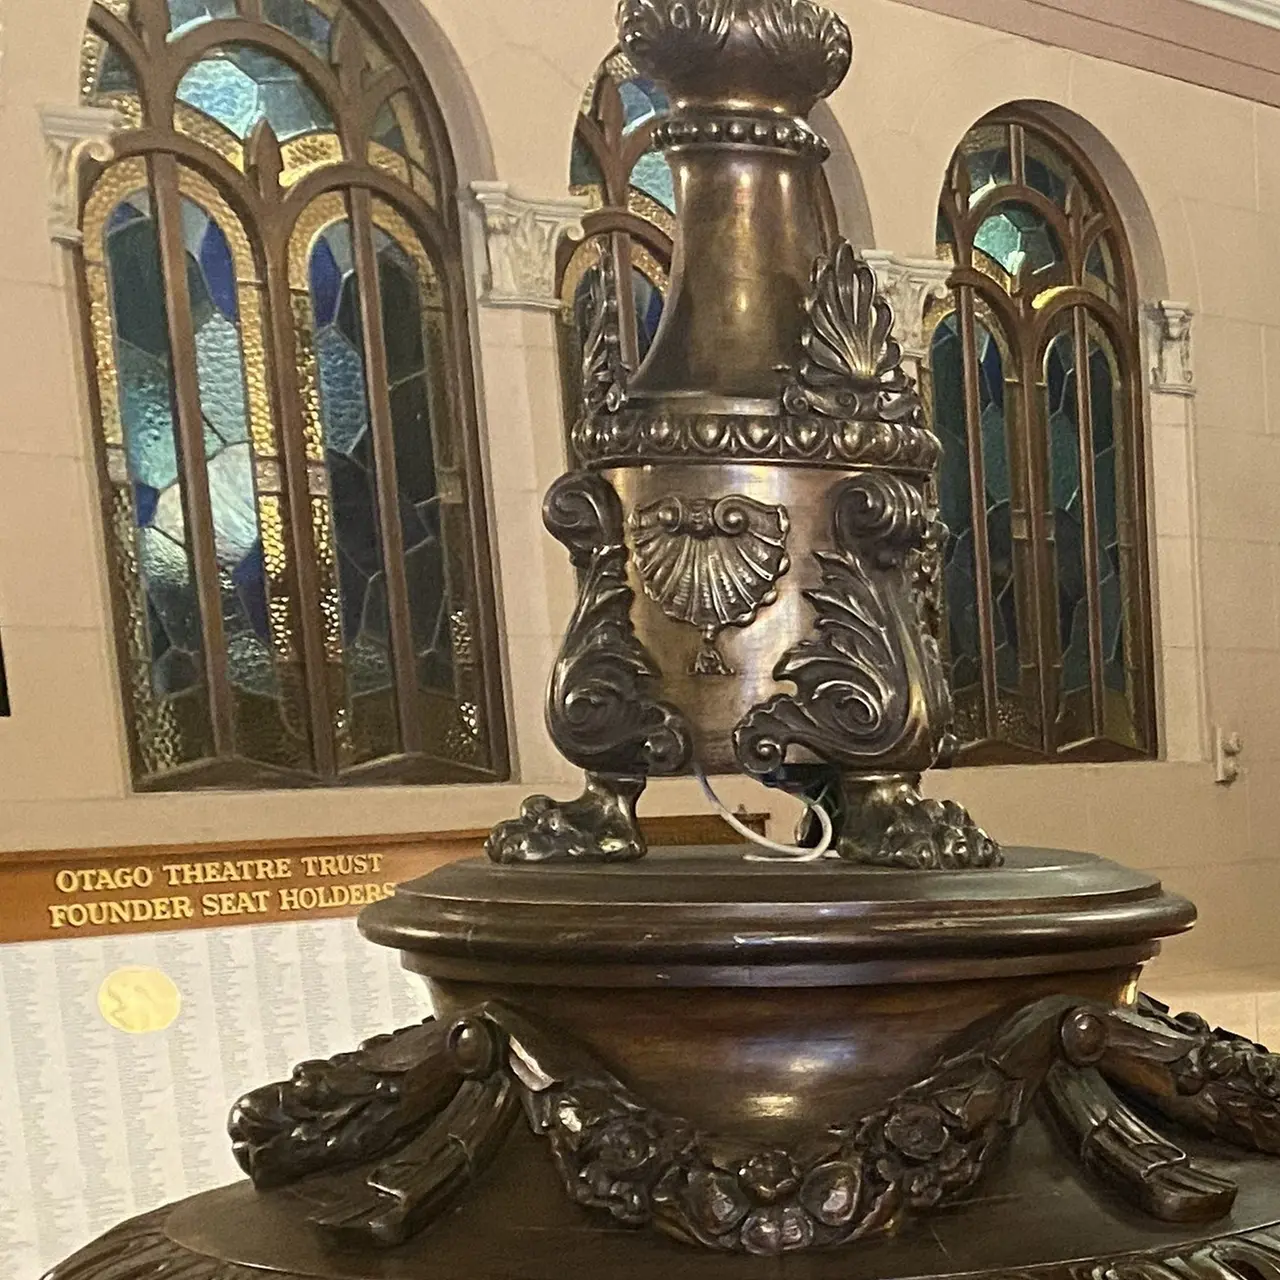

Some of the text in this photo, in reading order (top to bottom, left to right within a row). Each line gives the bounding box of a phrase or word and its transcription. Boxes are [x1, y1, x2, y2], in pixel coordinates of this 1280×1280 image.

[55, 853, 383, 893] OTAGO THEATRE TRUST
[48, 896, 194, 928] FOUNDER
[202, 890, 271, 917] SEAT
